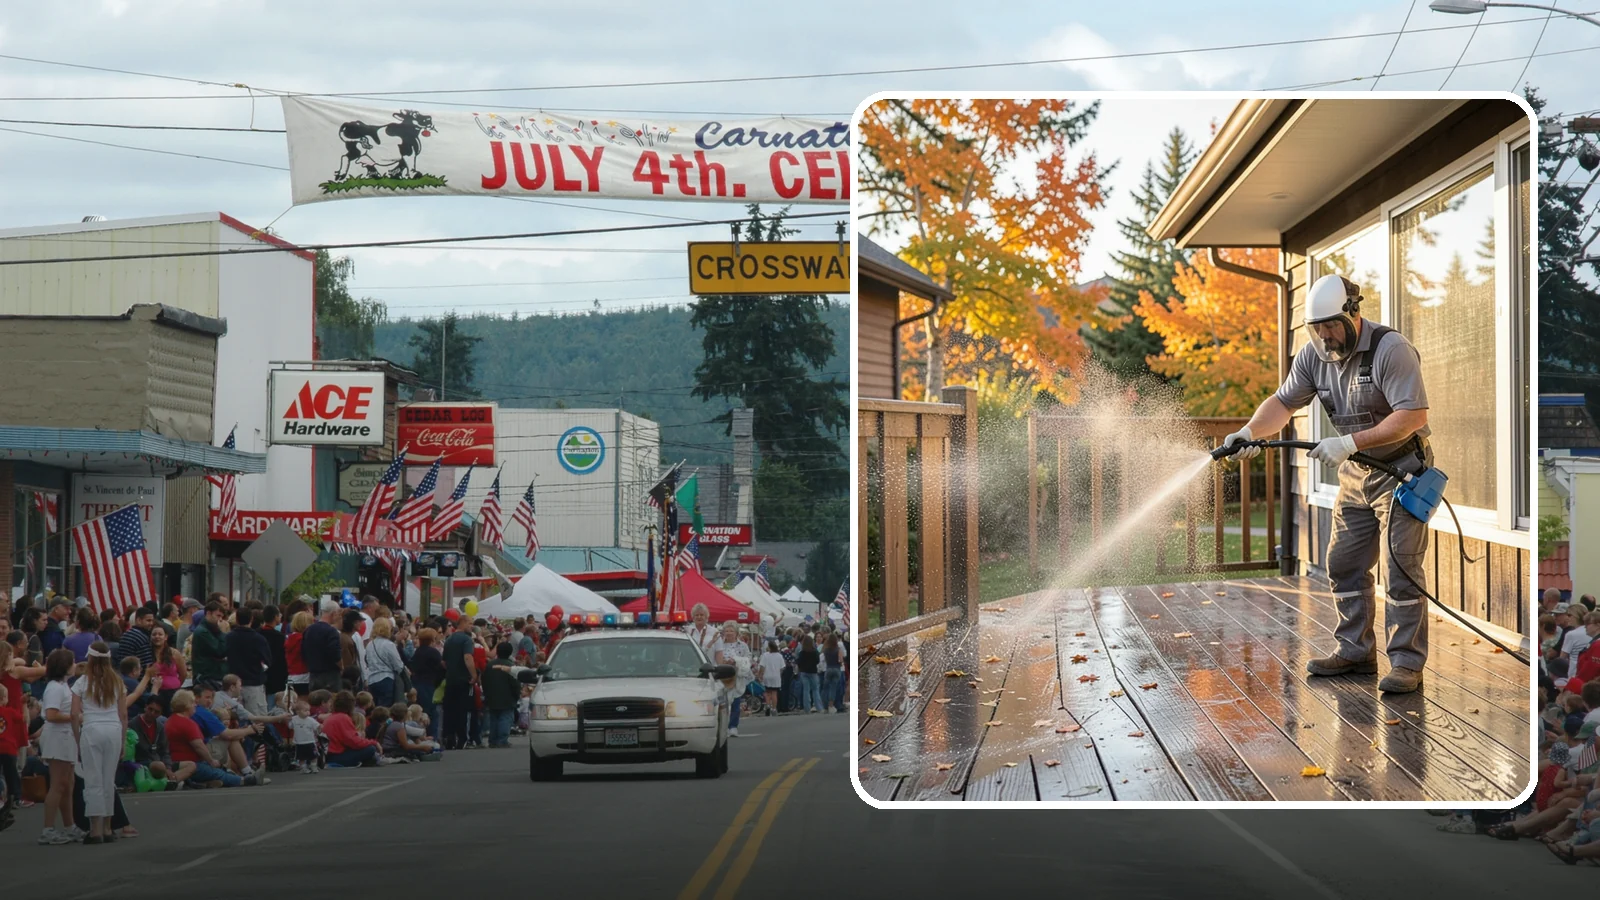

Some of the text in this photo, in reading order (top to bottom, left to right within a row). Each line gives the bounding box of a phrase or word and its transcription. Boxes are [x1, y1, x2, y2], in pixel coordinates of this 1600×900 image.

[695, 121, 850, 150] Carnat
[481, 141, 605, 192] JULY
[632, 149, 747, 198] 4th.
[697, 254, 850, 280] CROSSWA
[282, 380, 374, 420] ACE
[406, 409, 452, 422] CEDAR
[283, 421, 371, 436] Hardware
[416, 428, 476, 447] Coca-Cola
[353, 467, 386, 479] Simpl
[95, 485, 124, 495] Vincent
[126, 486, 135, 495] de
[138, 486, 155, 495] Paul
[688, 526, 741, 535] CRNATION
[699, 535, 730, 543] GLASS
